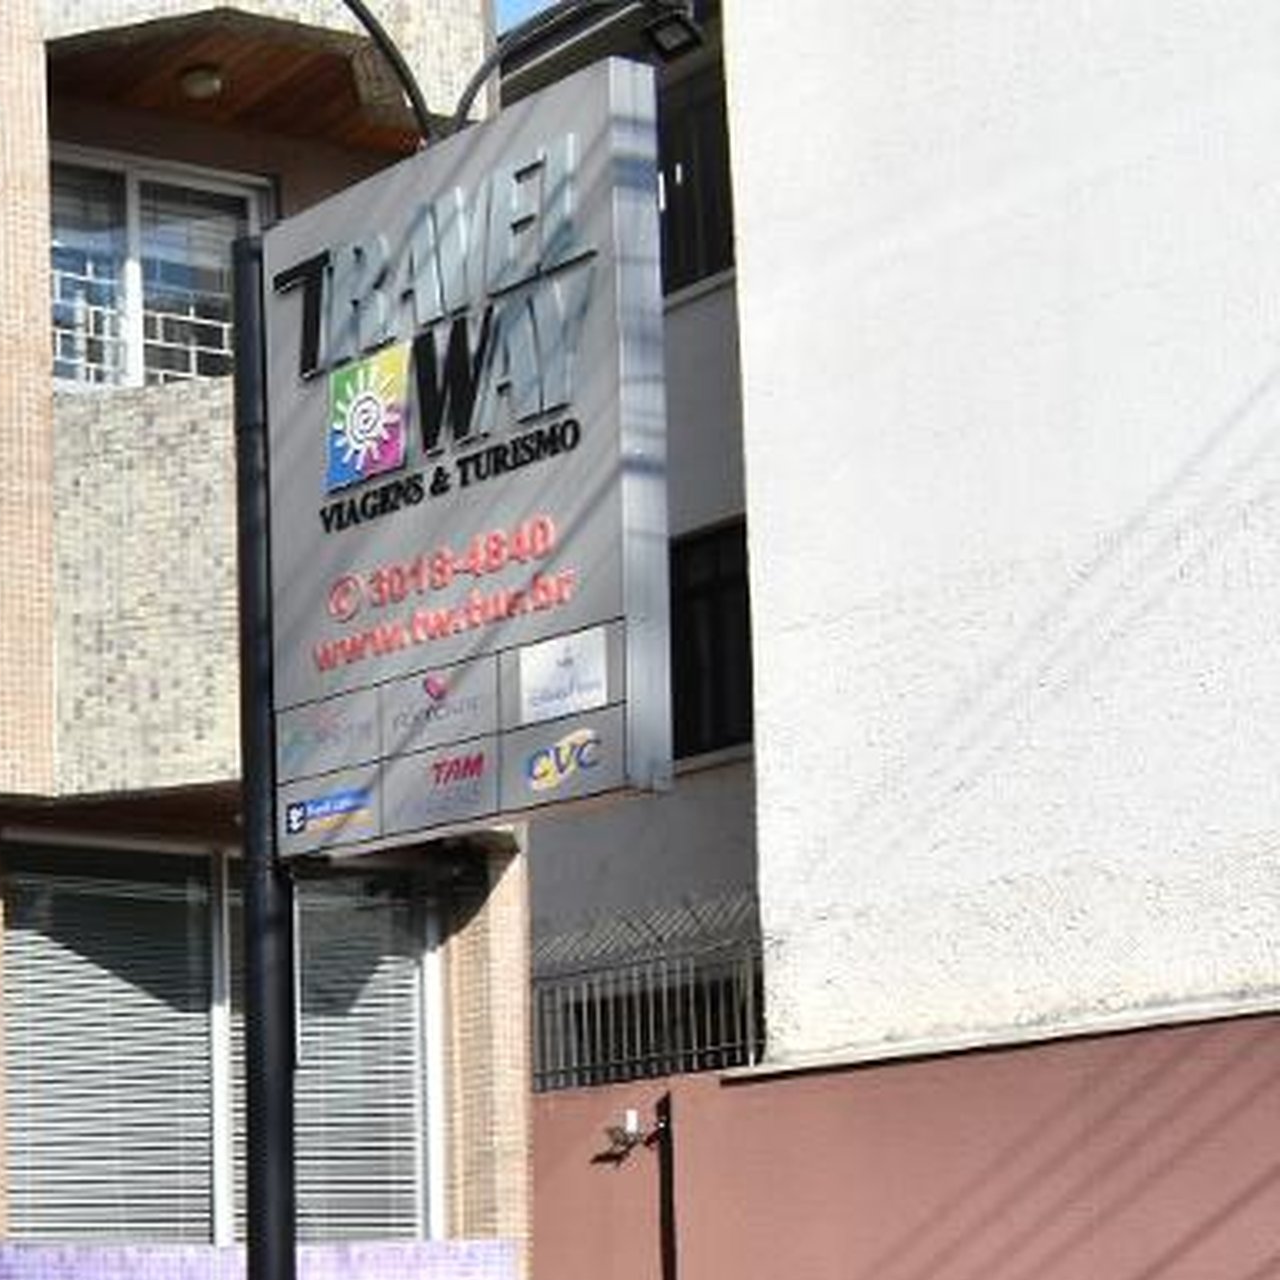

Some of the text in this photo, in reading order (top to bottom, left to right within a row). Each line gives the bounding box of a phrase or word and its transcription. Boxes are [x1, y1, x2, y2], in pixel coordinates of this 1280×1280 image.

[273, 134, 598, 380] TRAVEL
[412, 263, 597, 458] WAY
[319, 418, 581, 533] VIAGENS & TURISMO
[430, 752, 484, 786] TAM
